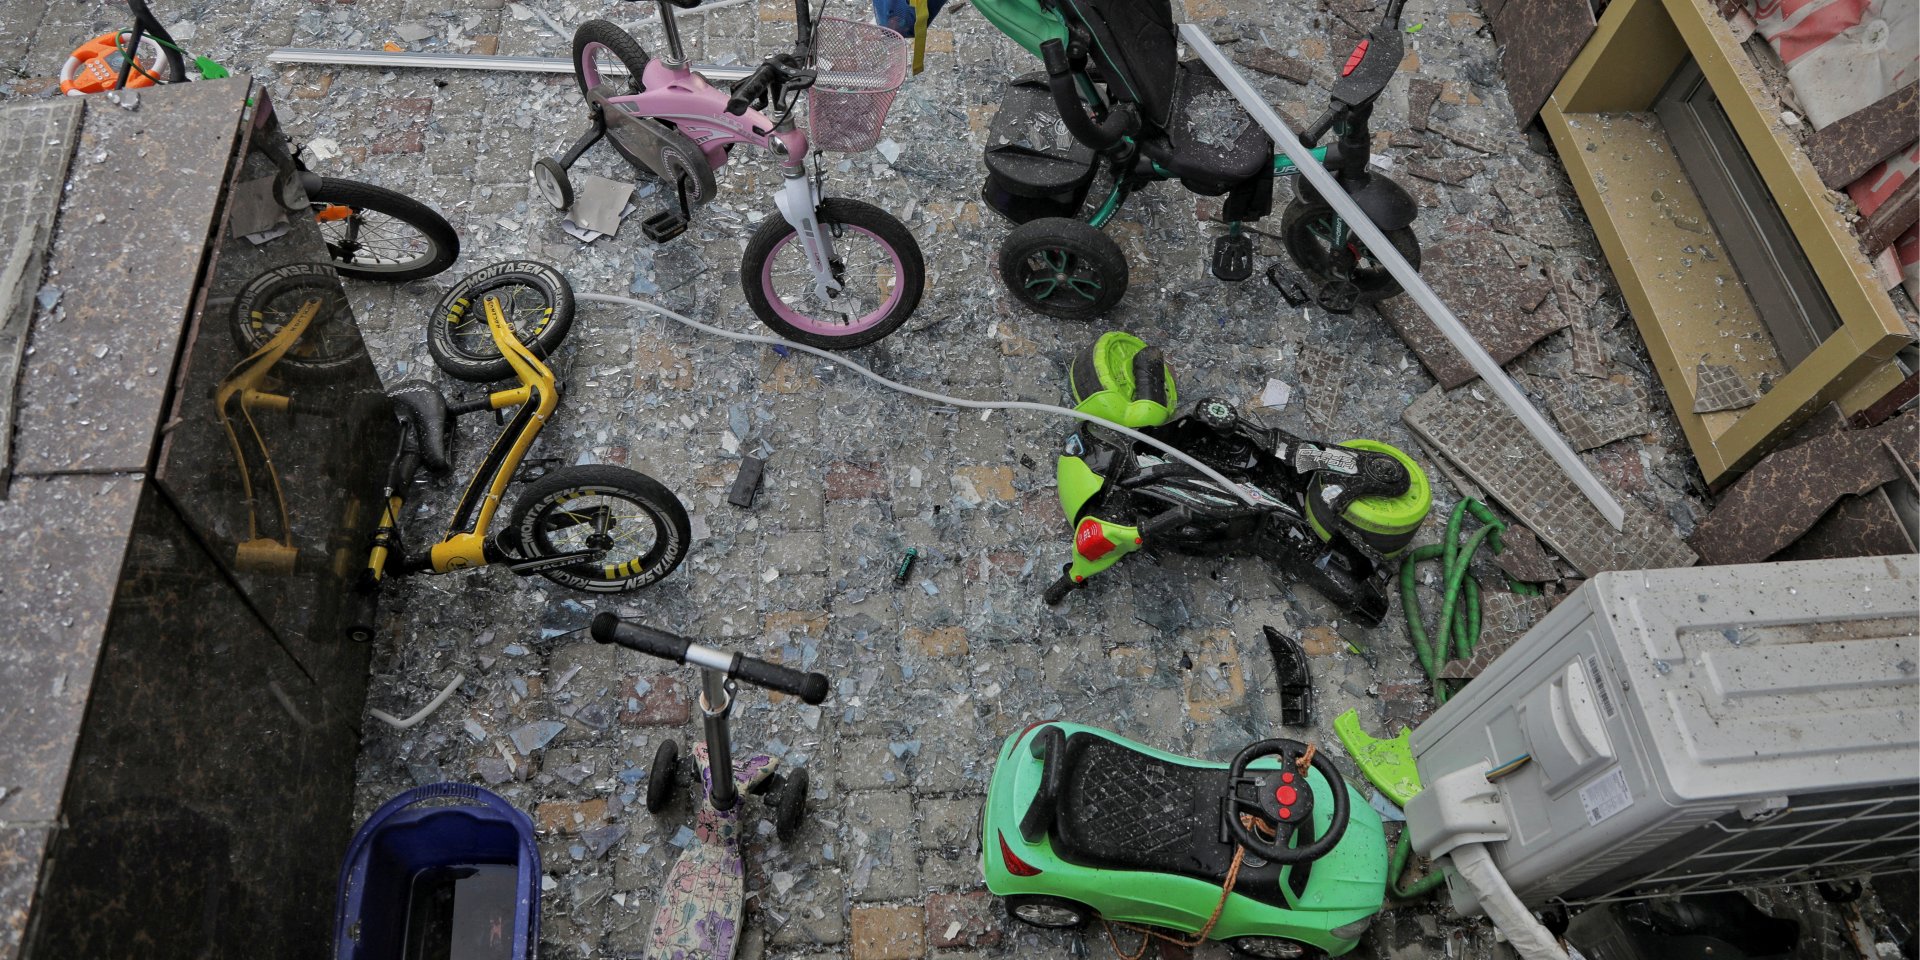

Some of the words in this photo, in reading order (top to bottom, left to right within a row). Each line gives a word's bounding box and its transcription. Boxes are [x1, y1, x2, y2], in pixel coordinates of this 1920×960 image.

[467, 262, 545, 289] MONTASEN
[434, 308, 449, 341] RACING
[616, 489, 663, 513] RACING
[521, 487, 576, 543] MONTASEN
[533, 557, 585, 571] RACING
[625, 535, 680, 590] MONTASEN
[551, 568, 590, 590] RACIN
